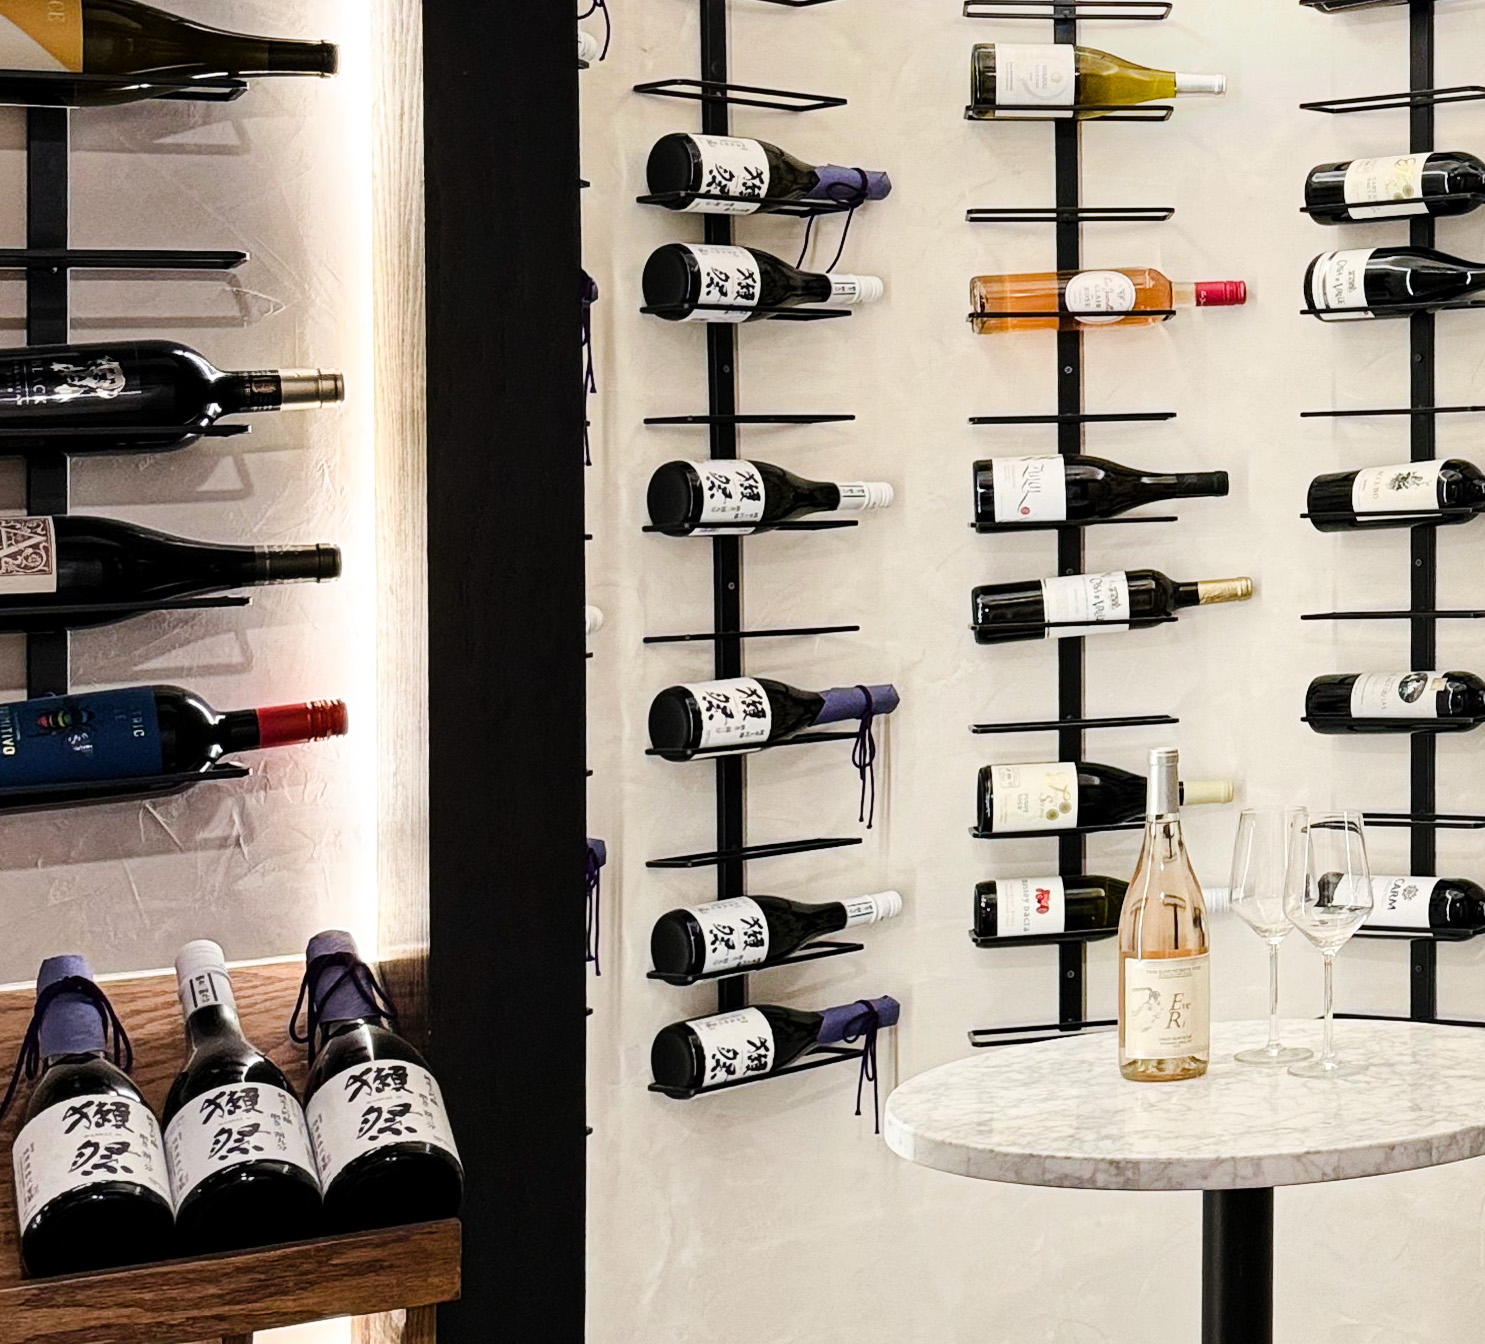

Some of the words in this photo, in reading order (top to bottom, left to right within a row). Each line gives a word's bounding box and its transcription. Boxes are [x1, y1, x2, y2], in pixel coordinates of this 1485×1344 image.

[1387, 877, 1406, 911] CARM
[61, 1099, 142, 1177] 獺祭
[199, 1086, 272, 1162] 獺祭
[343, 1064, 424, 1142] 獺祭
